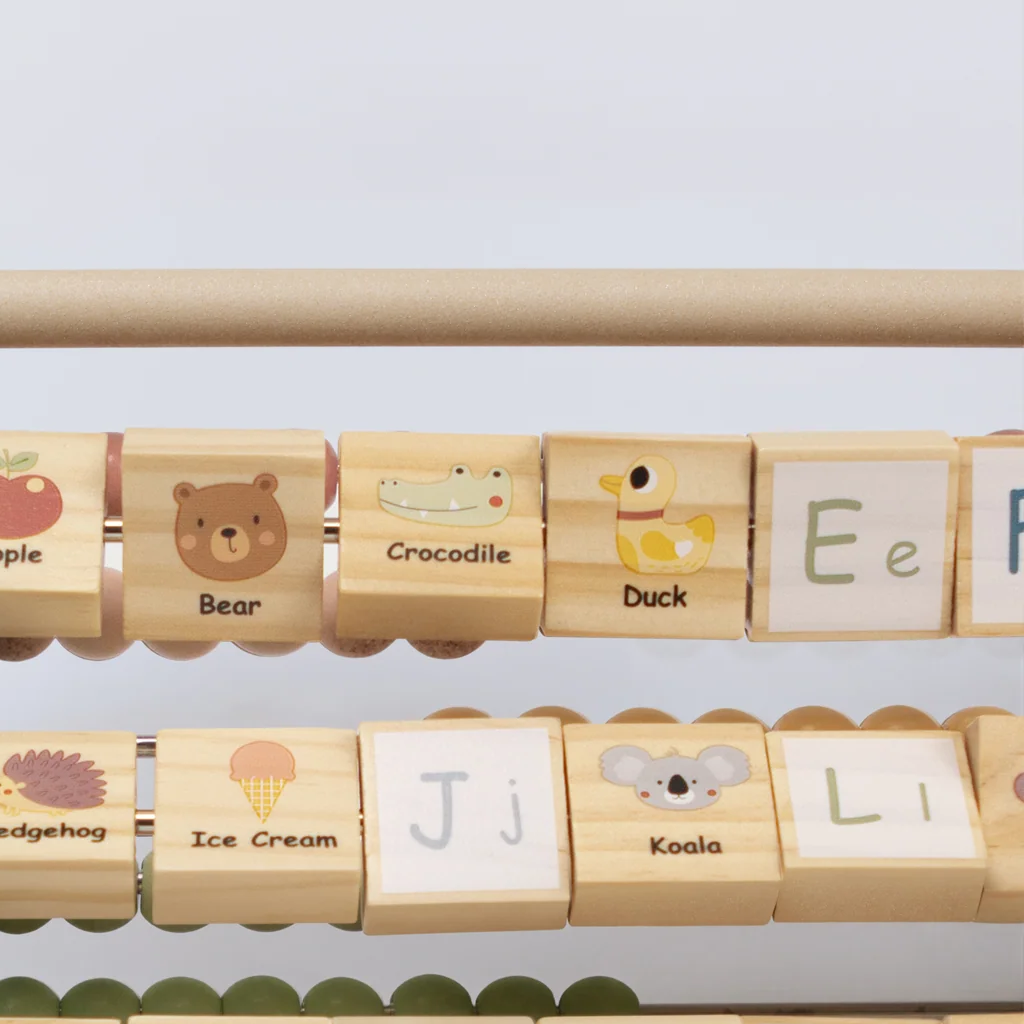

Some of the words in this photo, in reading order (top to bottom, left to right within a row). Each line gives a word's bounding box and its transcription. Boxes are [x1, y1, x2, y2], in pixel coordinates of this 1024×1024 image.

[386, 541, 512, 564] Crocodile
[199, 593, 262, 616] Bear
[623, 583, 687, 608] Duck
[191, 831, 237, 848] Ice
[251, 831, 338, 848] Cream
[650, 835, 723, 856] Koala
